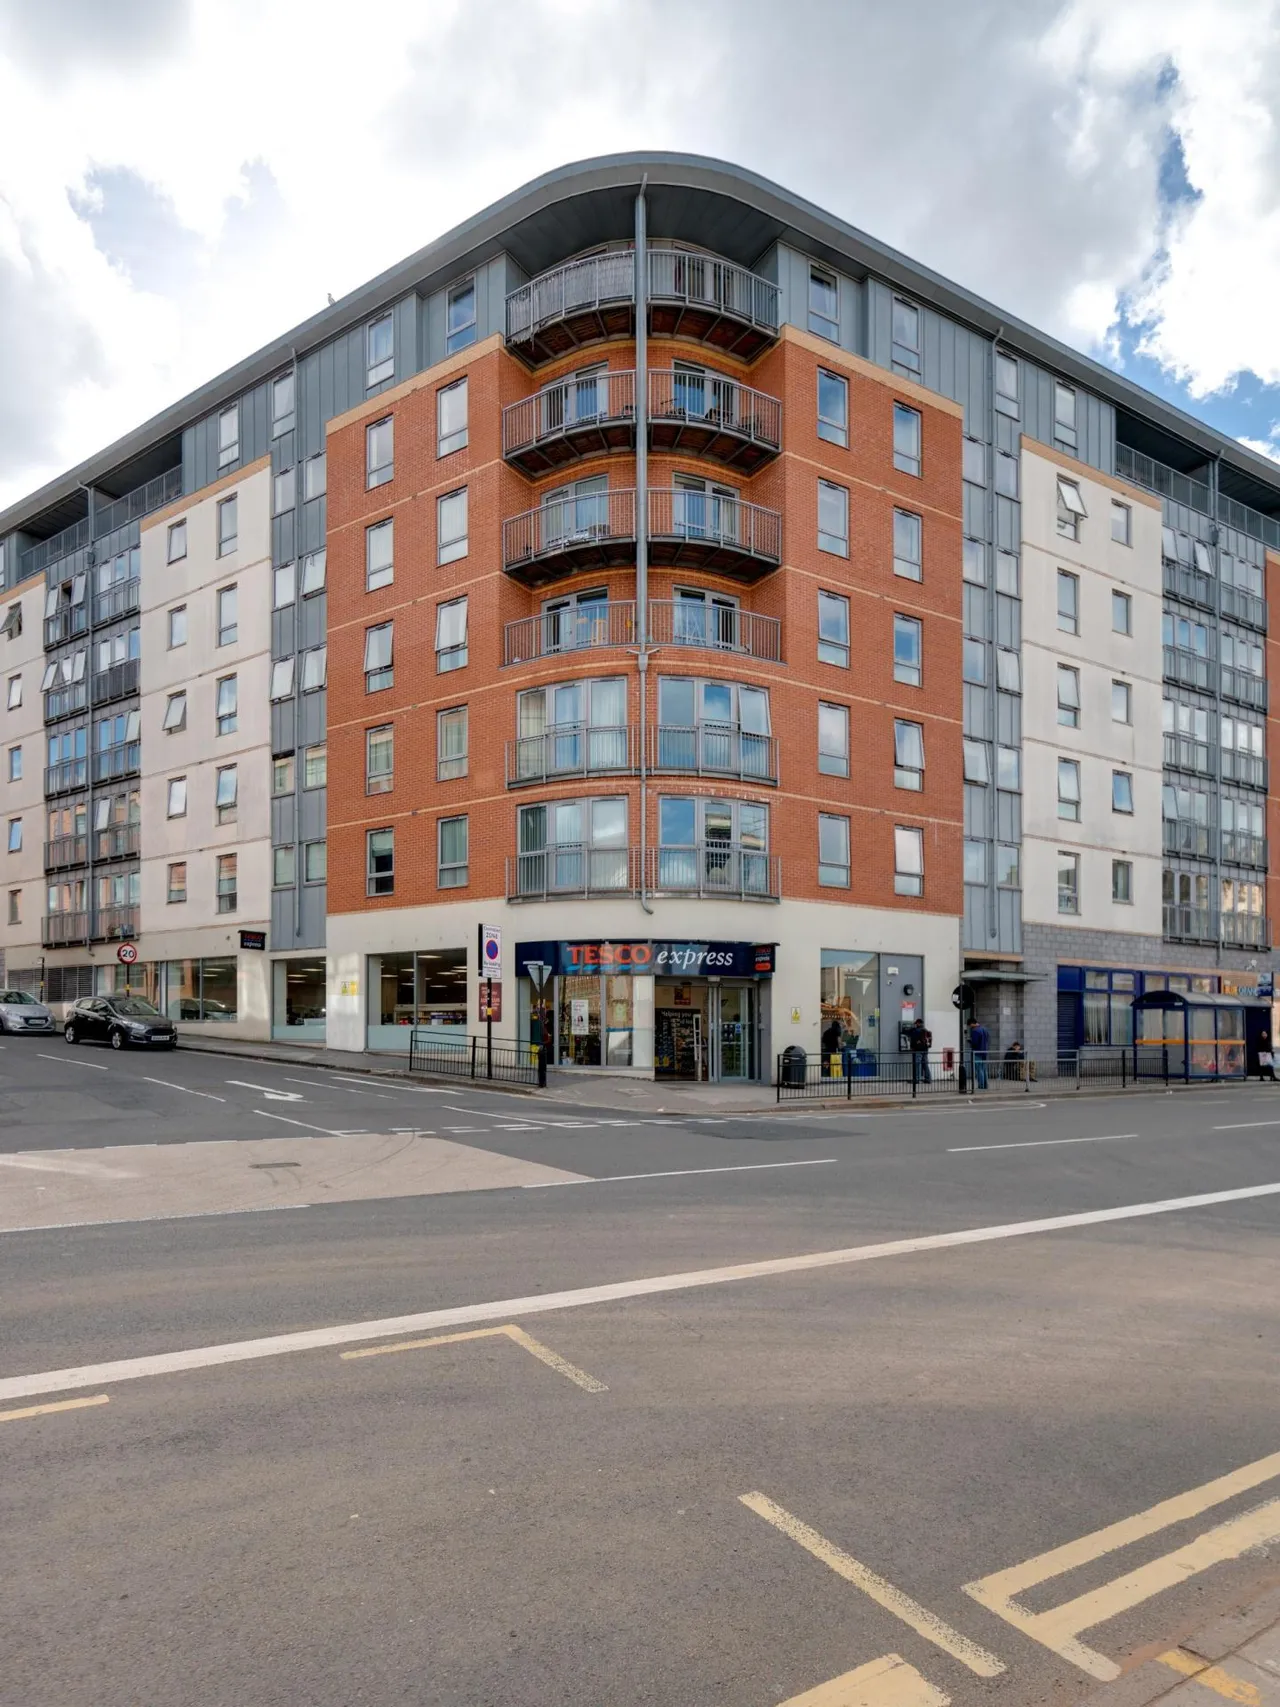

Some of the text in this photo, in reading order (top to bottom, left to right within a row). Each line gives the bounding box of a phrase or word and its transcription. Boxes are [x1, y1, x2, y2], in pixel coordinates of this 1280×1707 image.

[122, 949, 135, 958] 20
[566, 944, 734, 970] TESCO express
